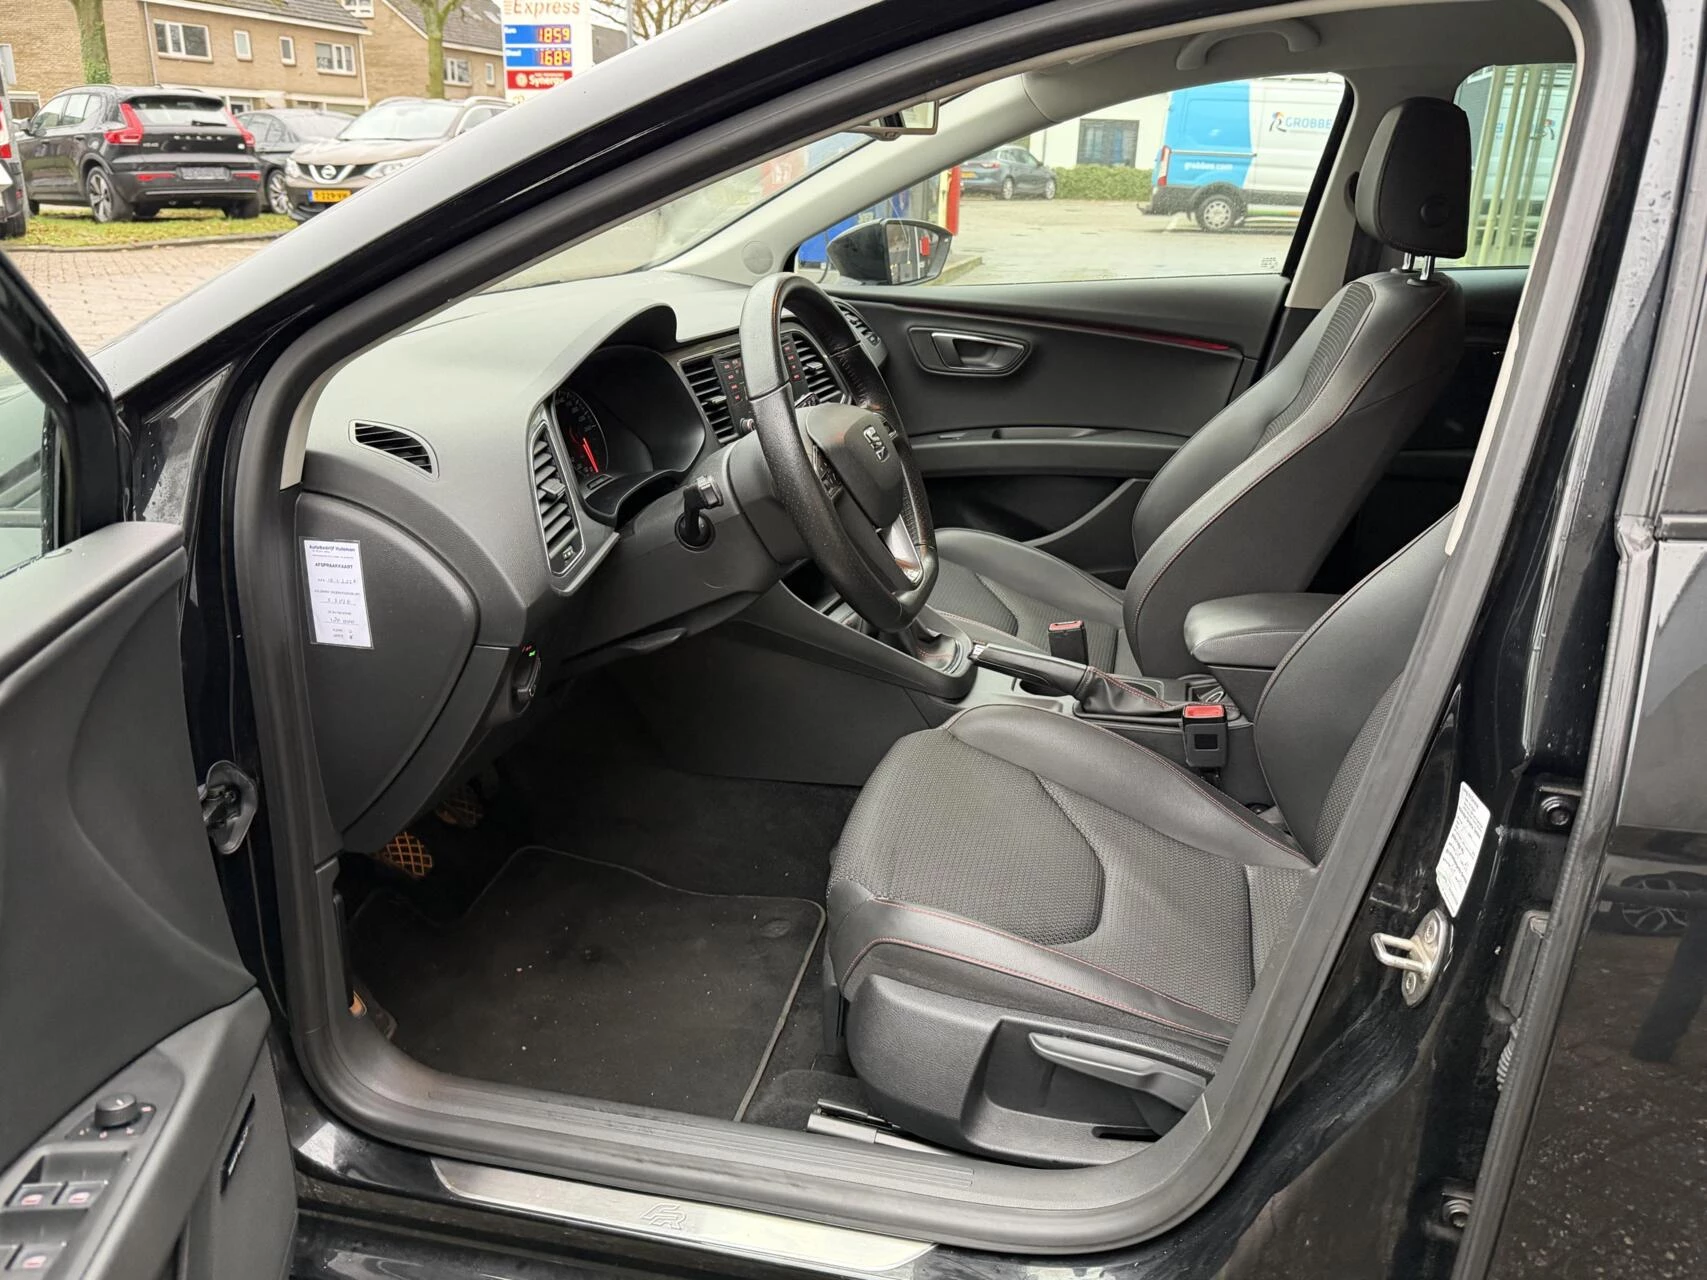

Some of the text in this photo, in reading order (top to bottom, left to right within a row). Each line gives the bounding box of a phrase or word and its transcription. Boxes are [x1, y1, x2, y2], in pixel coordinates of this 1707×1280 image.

[514, 0, 580, 17] Express
[538, 27, 570, 43] 1859
[540, 50, 571, 66] 1689
